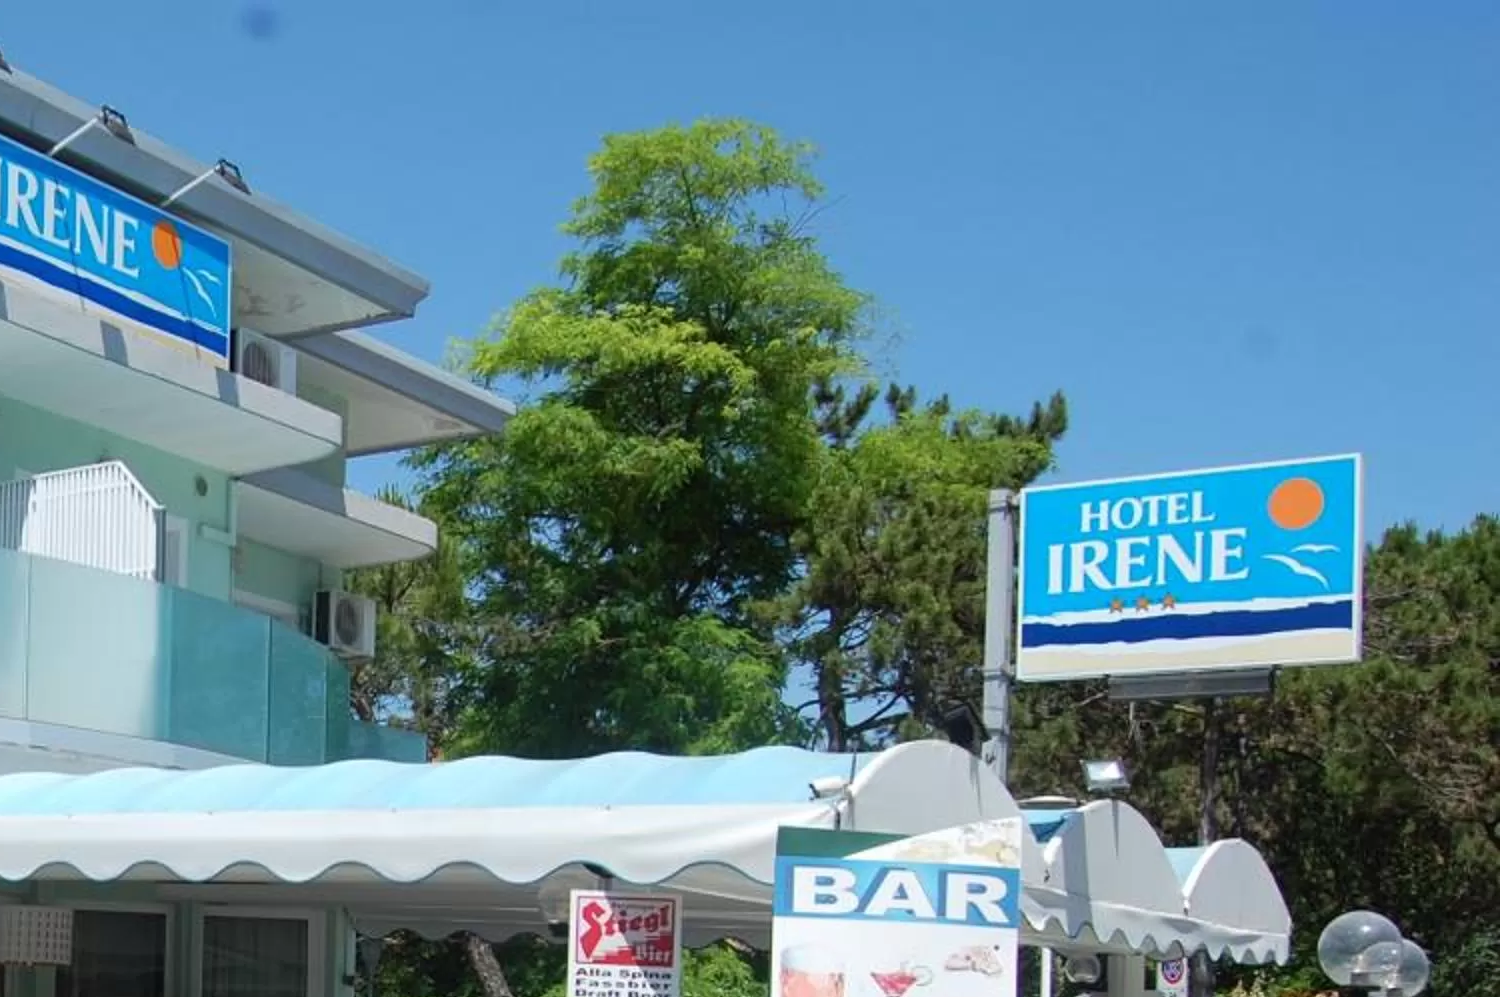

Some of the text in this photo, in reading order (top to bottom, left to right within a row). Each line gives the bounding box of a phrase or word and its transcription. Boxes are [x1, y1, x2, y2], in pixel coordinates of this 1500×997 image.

[1079, 490, 1216, 533] HOTEL
[1047, 528, 1249, 595] IRENE
[792, 865, 1010, 923] BAR
[580, 901, 670, 960] Stiegl
[576, 967, 612, 977] Alla
